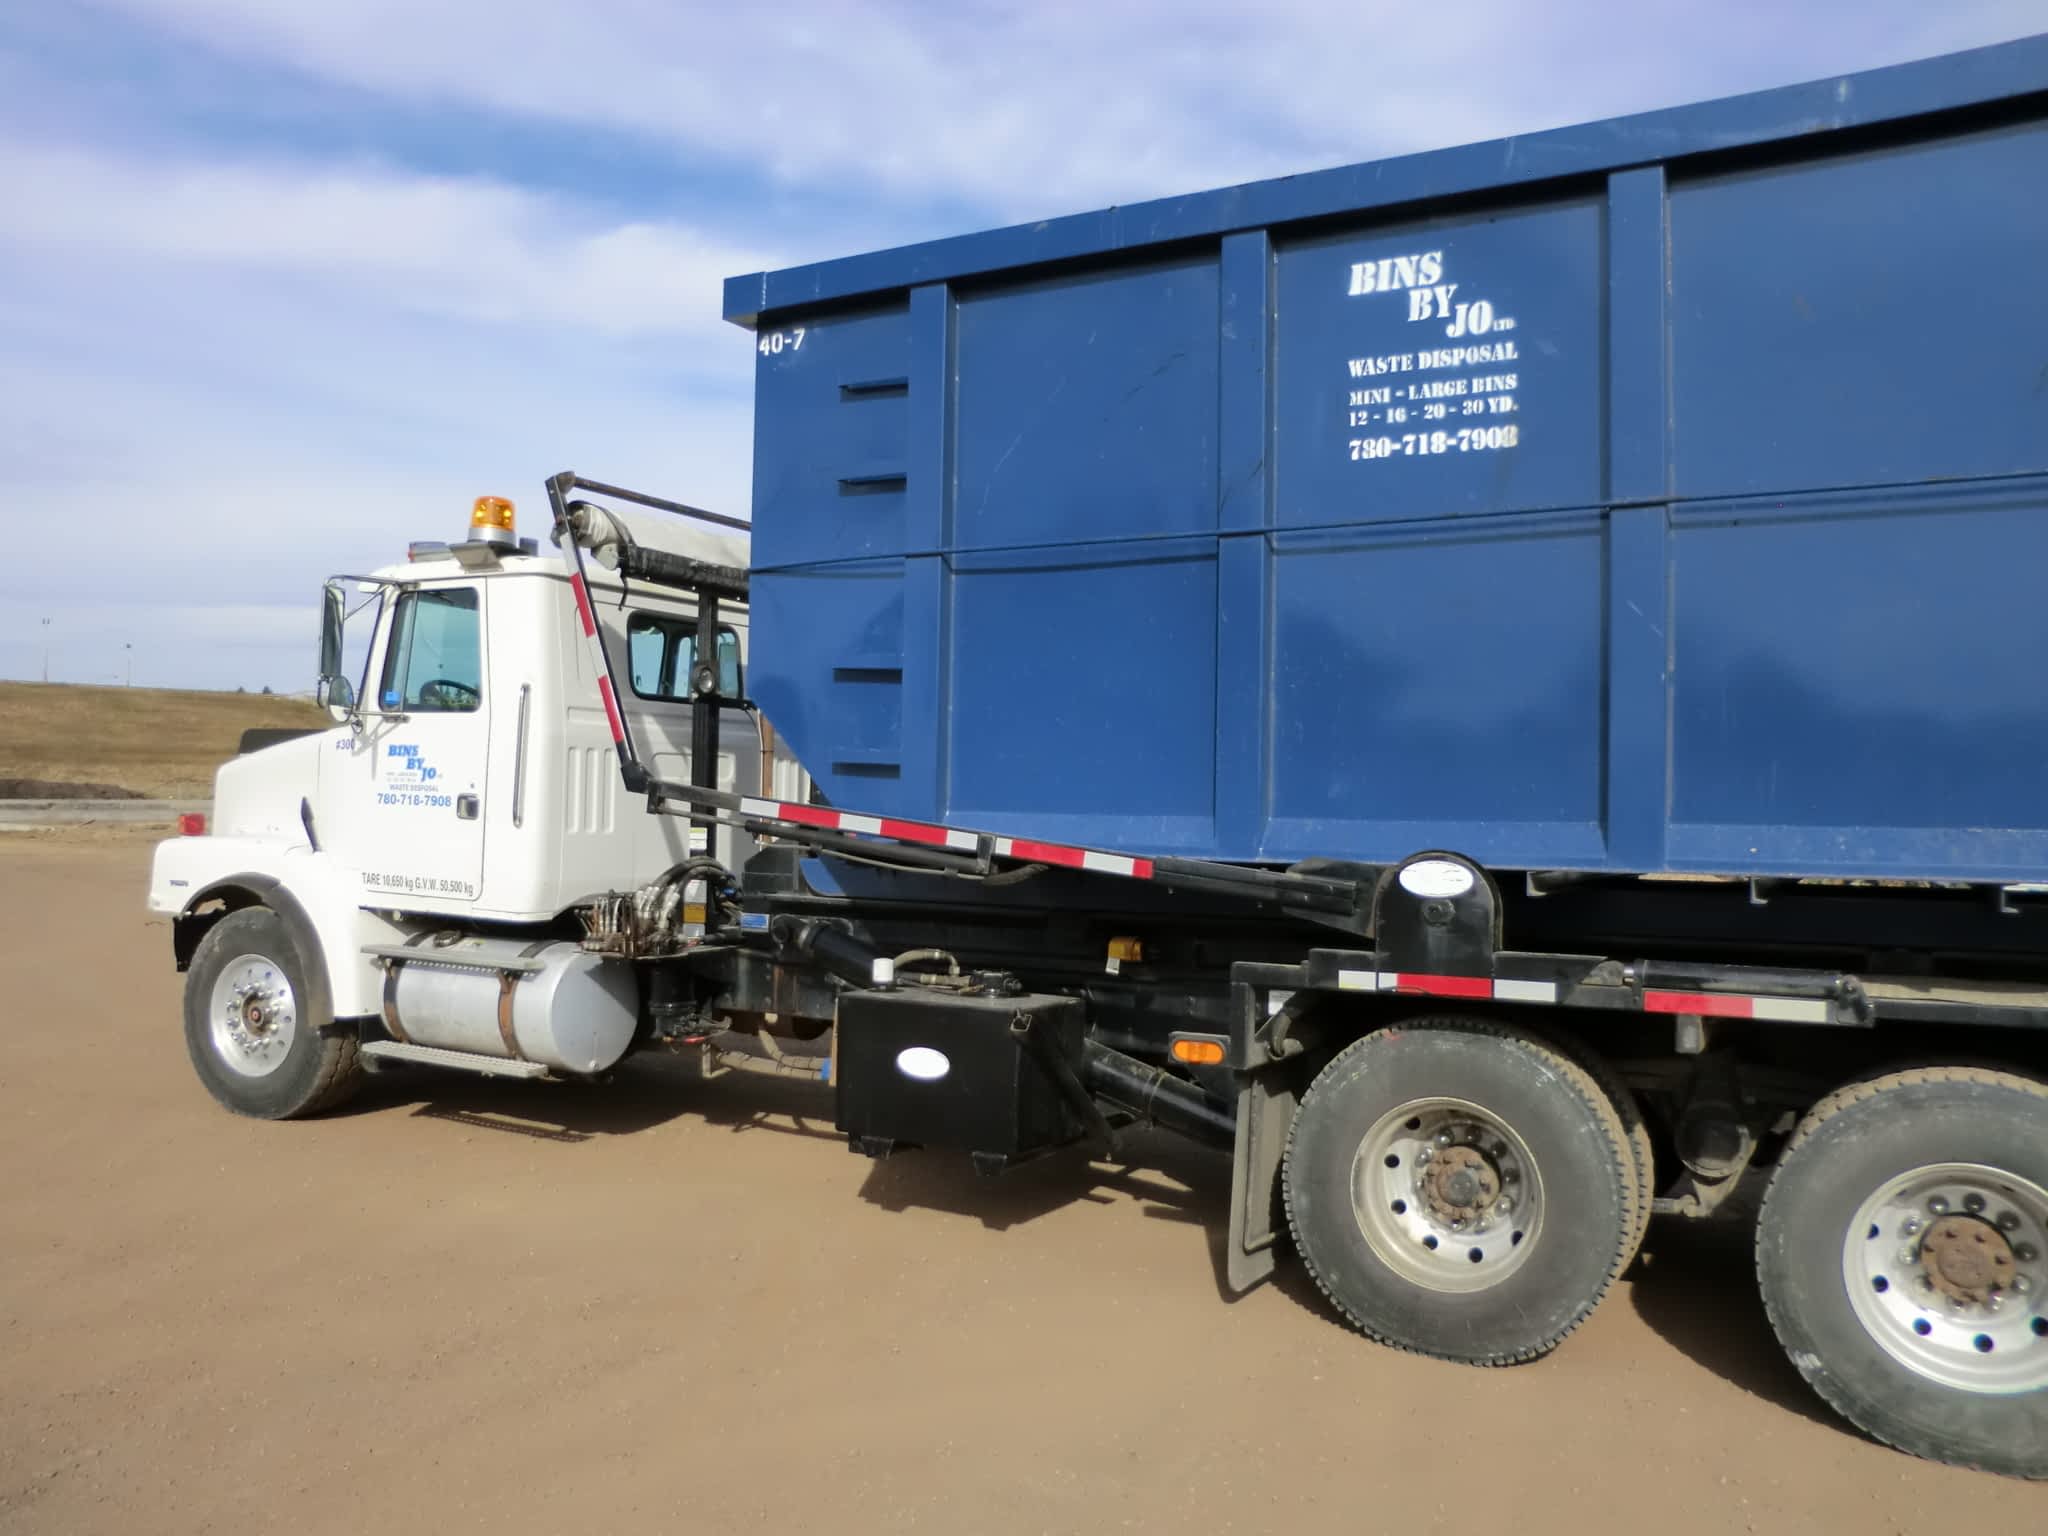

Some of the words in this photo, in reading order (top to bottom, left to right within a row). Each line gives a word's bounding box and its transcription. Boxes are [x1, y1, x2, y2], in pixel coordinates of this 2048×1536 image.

[1348, 250, 1442, 296] BINS
[1408, 285, 1458, 321] BY
[1446, 300, 1493, 337] JO
[759, 328, 805, 356] 40-7
[1348, 354, 1413, 378] WASTE
[1418, 342, 1518, 370] DISPOSAL
[1349, 387, 1390, 406] MINI
[1408, 380, 1467, 400] LARGE
[1472, 374, 1517, 393] BINS
[1349, 411, 1368, 426] 12
[1386, 408, 1406, 423] 16
[1423, 403, 1445, 419] 20
[1462, 399, 1483, 415] 30
[1349, 425, 1518, 461] 780-718-7908
[388, 744, 419, 757] BINS
[406, 758, 425, 770] BY
[421, 767, 437, 782] JO
[377, 792, 452, 807] 780-718-7908
[361, 872, 381, 886] TARE
[405, 876, 414, 892] kg
[415, 877, 439, 891] G.V.W.
[464, 881, 474, 897] kg
